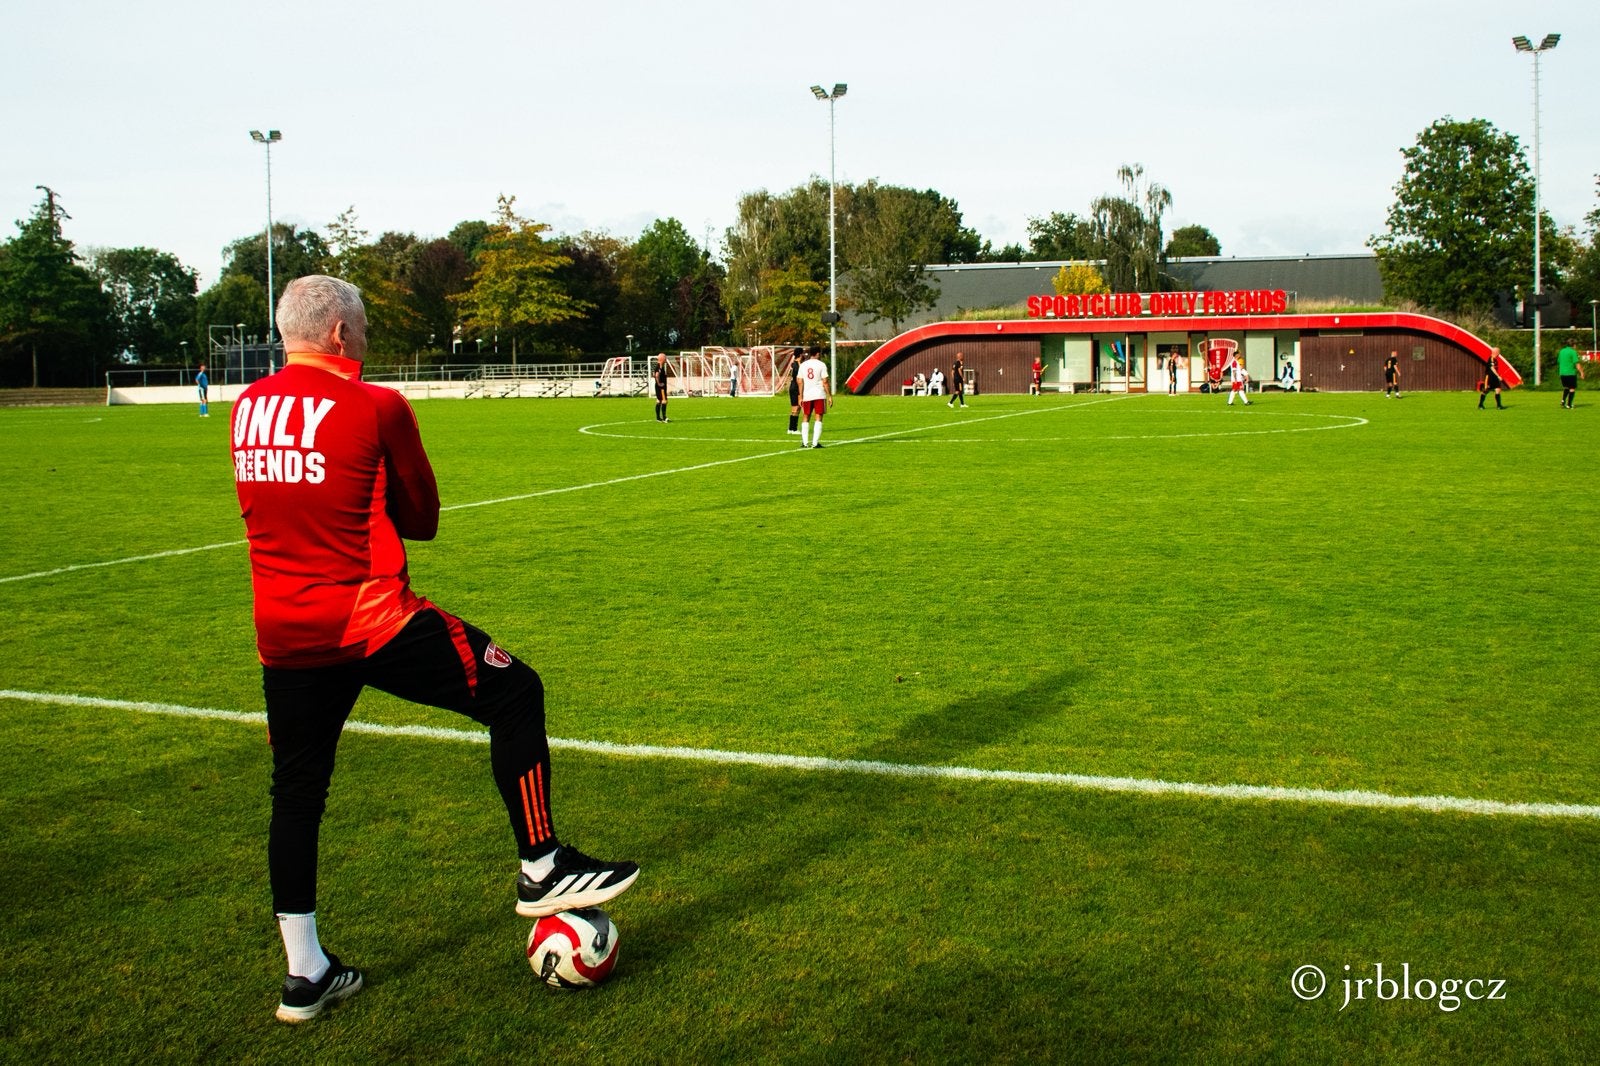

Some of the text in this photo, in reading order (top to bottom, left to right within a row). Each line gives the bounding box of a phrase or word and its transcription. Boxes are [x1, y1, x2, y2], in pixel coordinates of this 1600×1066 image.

[1027, 290, 1287, 317] SPORTCLUB ONLY FRIENDS
[807, 367, 814, 379] 8
[233, 394, 336, 448] ONLY
[233, 448, 326, 484] FRIENDS
